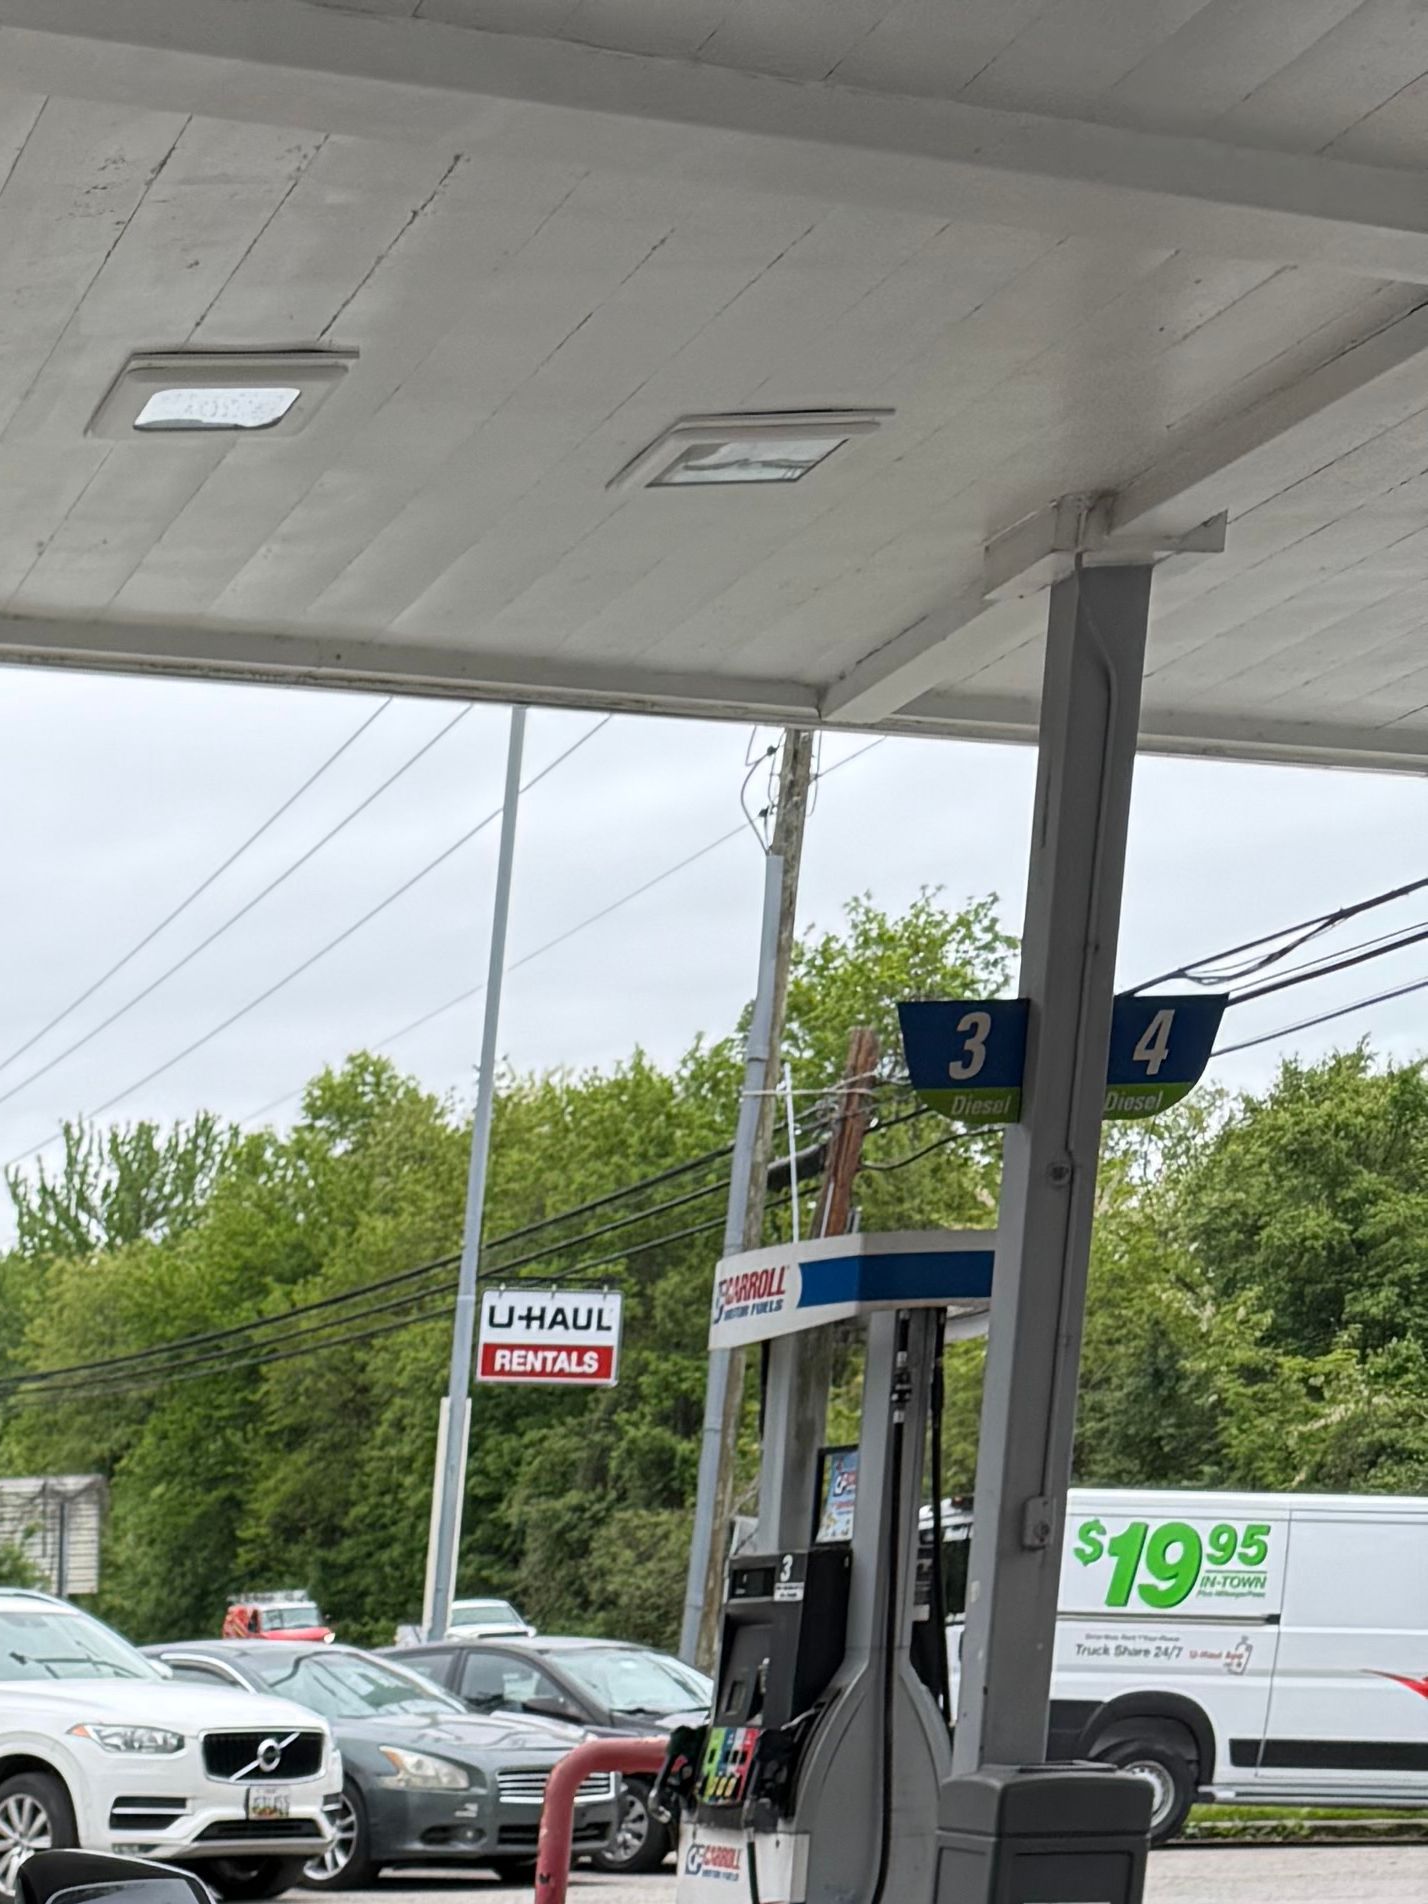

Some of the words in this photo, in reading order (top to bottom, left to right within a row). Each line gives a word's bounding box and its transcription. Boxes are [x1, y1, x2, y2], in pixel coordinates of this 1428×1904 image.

[949, 1011, 991, 1080] 3
[1133, 1009, 1175, 1075] 4
[951, 1096, 1009, 1116] Diesel
[1104, 1091, 1163, 1112] Diesel
[489, 1305, 612, 1331] U-HAUL
[494, 1349, 599, 1374] RENTALS
[780, 1554, 793, 1582] 3
[1200, 1575, 1267, 1589] IN-TOWN
